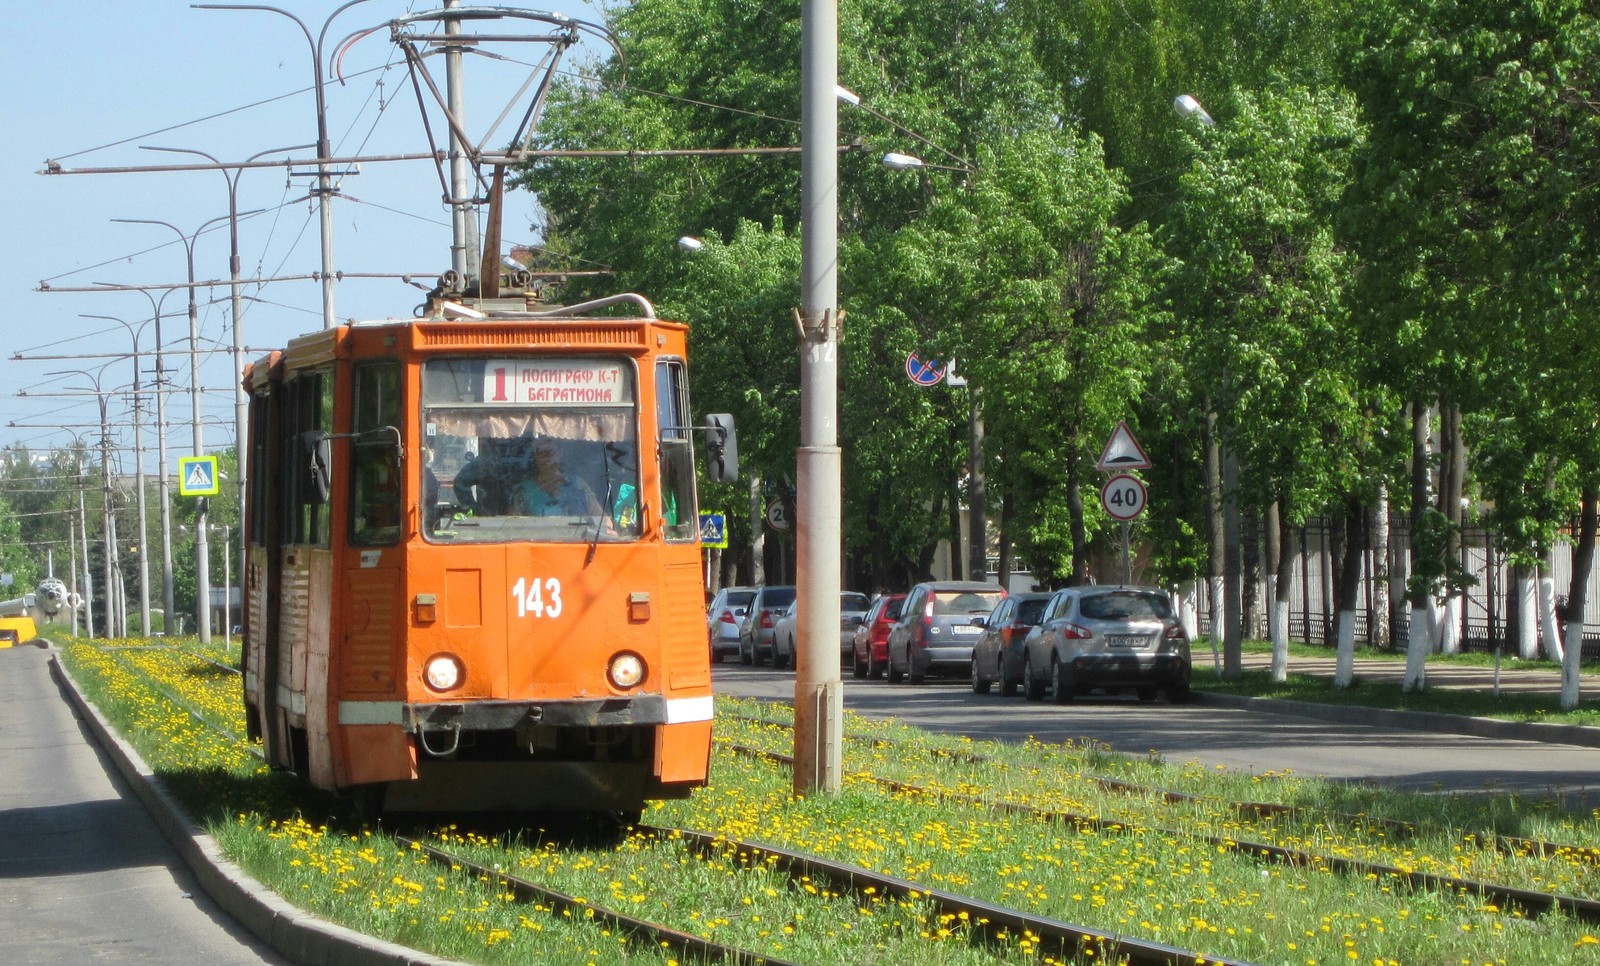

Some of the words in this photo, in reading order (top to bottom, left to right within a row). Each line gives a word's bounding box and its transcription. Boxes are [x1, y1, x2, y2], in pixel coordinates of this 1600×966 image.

[492, 367, 508, 401] 1
[522, 368, 594, 384] ПОЛИГРАФ
[598, 369, 619, 384] К-Т
[528, 388, 612, 402] БАГРАТИОНА
[1110, 488, 1137, 507] 40
[512, 577, 562, 618] 143
